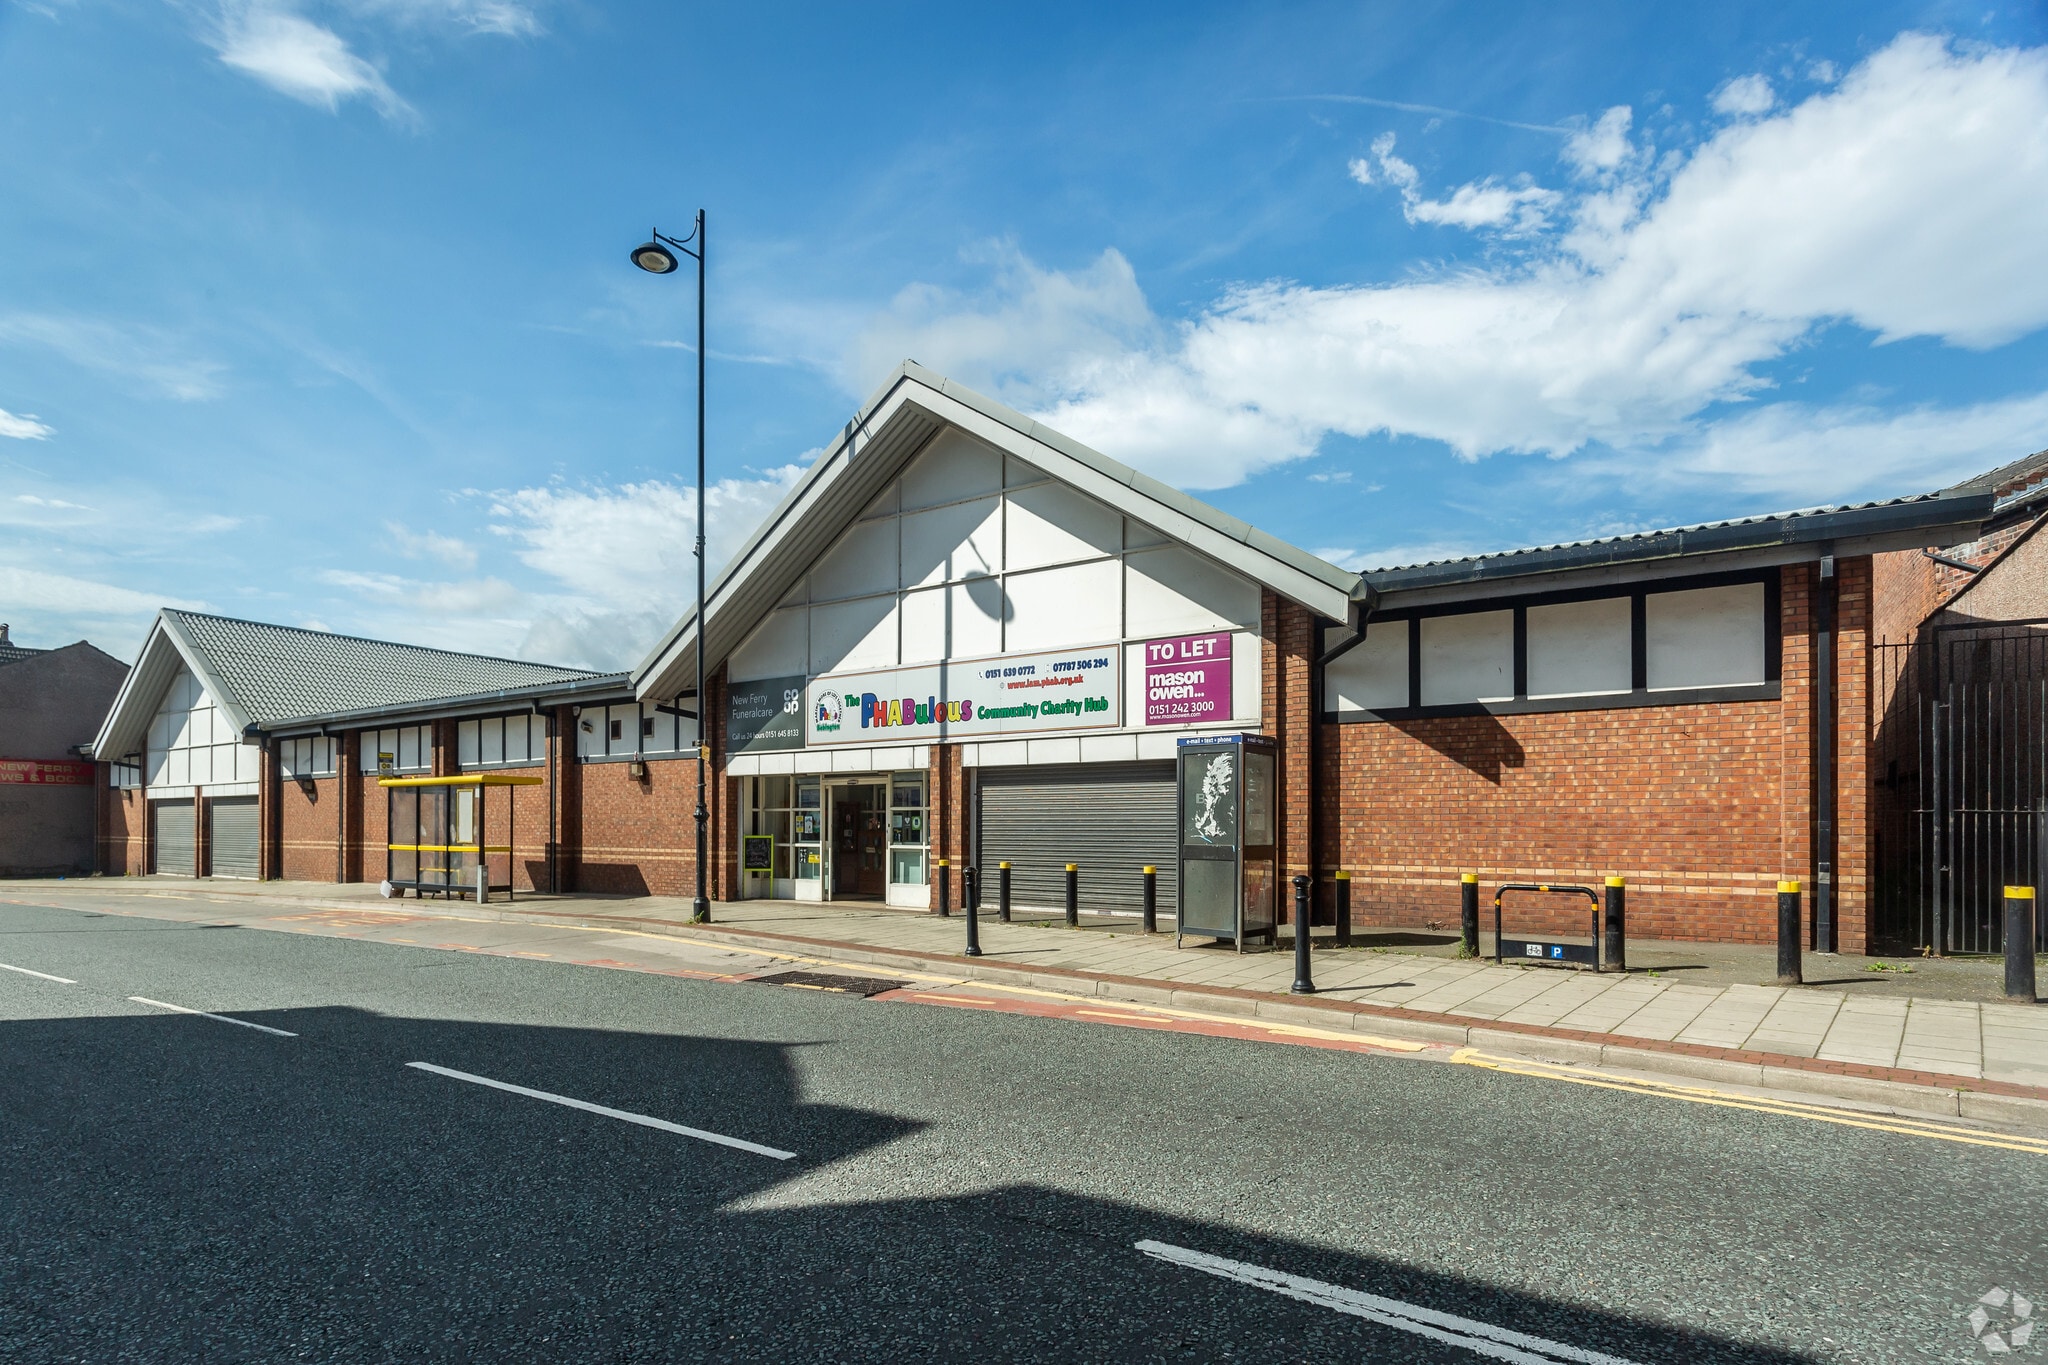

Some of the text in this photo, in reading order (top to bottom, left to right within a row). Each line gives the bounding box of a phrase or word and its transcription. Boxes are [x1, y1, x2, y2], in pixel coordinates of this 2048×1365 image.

[1149, 638, 1217, 661] TO LET
[1053, 658, 1109, 672] 07787 506 294
[985, 665, 1036, 679] 0151 639 0772
[1149, 670, 1205, 687] mason
[732, 694, 768, 706] New Ferry
[732, 707, 773, 720] Funeralcare
[844, 693, 973, 729] The PHABulous
[977, 696, 1109, 720] Community Charity Hub
[1149, 701, 1215, 715] 0151 242 3000
[1149, 712, 1202, 720] www.masonowen.com
[753, 731, 765, 739] hours
[765, 730, 777, 738] 0151
[35, 764, 82, 773] FERRY
[1, 773, 93, 784] WS & BOO
[1553, 947, 1561, 958] P
